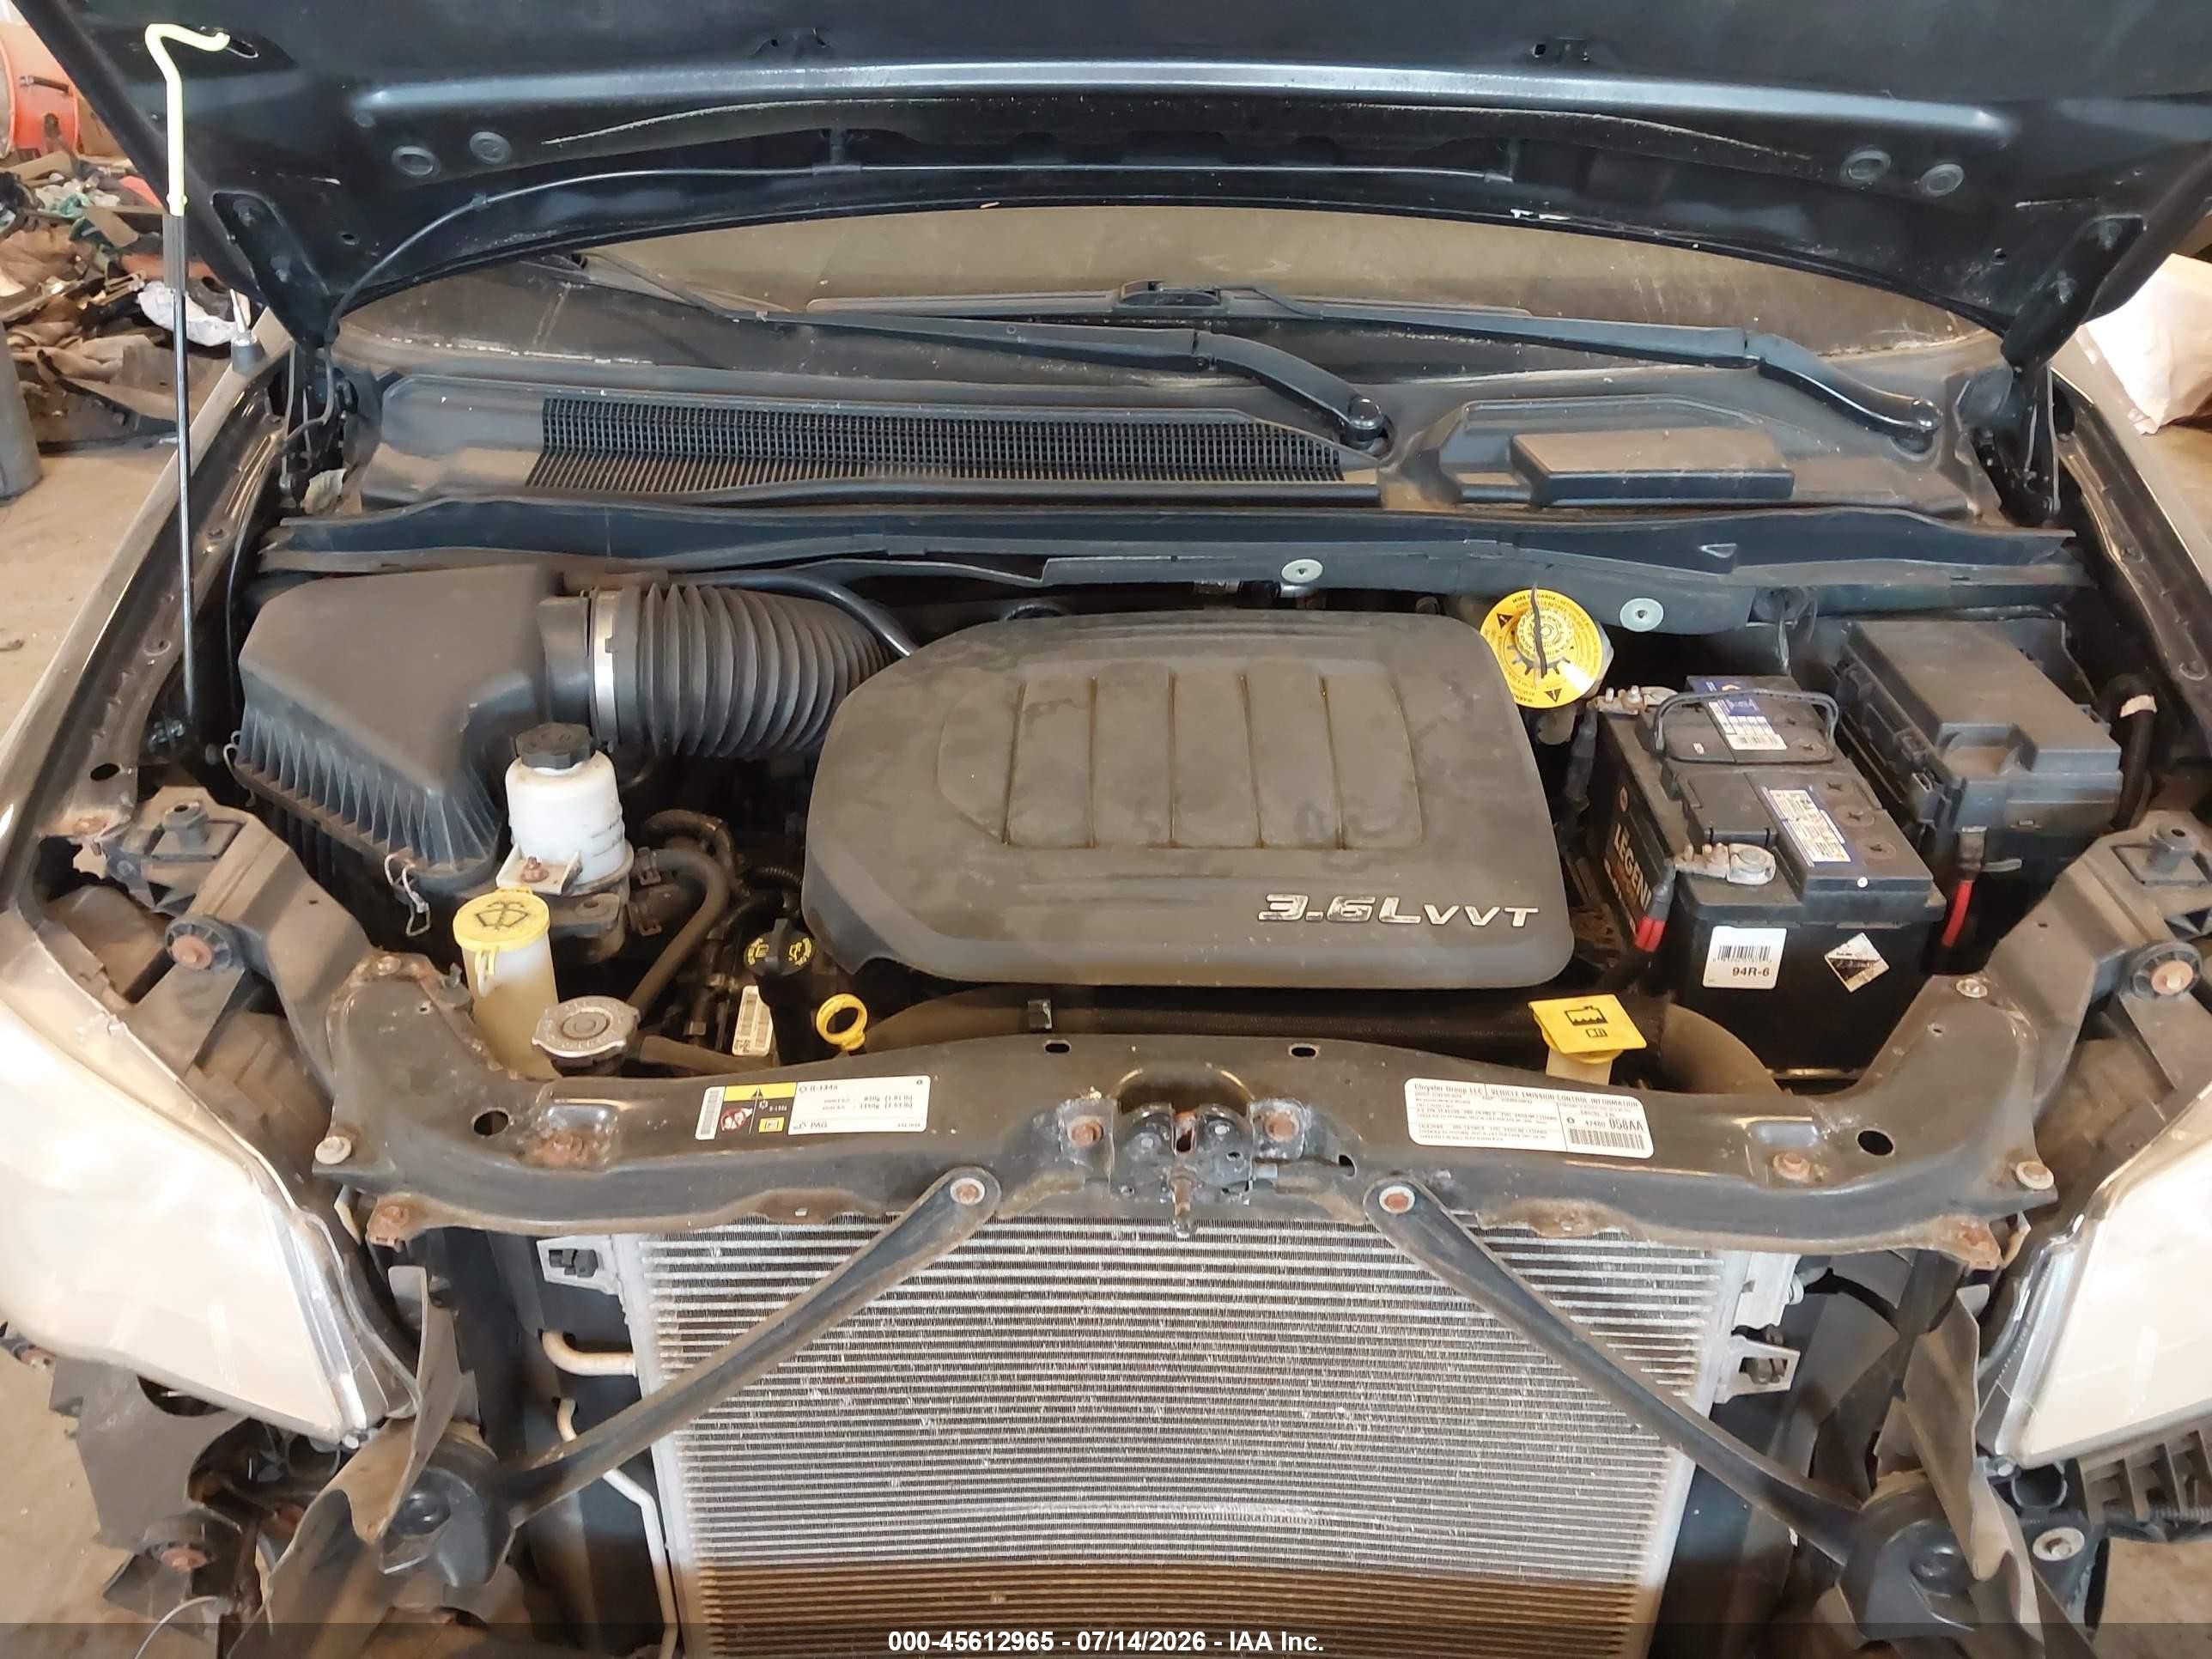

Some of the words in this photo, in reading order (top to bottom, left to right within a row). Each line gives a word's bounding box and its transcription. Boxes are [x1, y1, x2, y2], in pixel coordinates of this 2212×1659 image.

[1732, 966, 1771, 977] 94R-6
[1414, 1083, 1443, 1093] Chrysler
[1445, 1085, 1468, 1096] Group
[1491, 1088, 1519, 1097] VEHICLE
[1522, 1091, 1555, 1100] EMISSION
[1557, 1094, 1588, 1103] CONTROL
[1590, 1097, 1638, 1108] INFORMATION
[1608, 1118, 1644, 1132] 058AA
